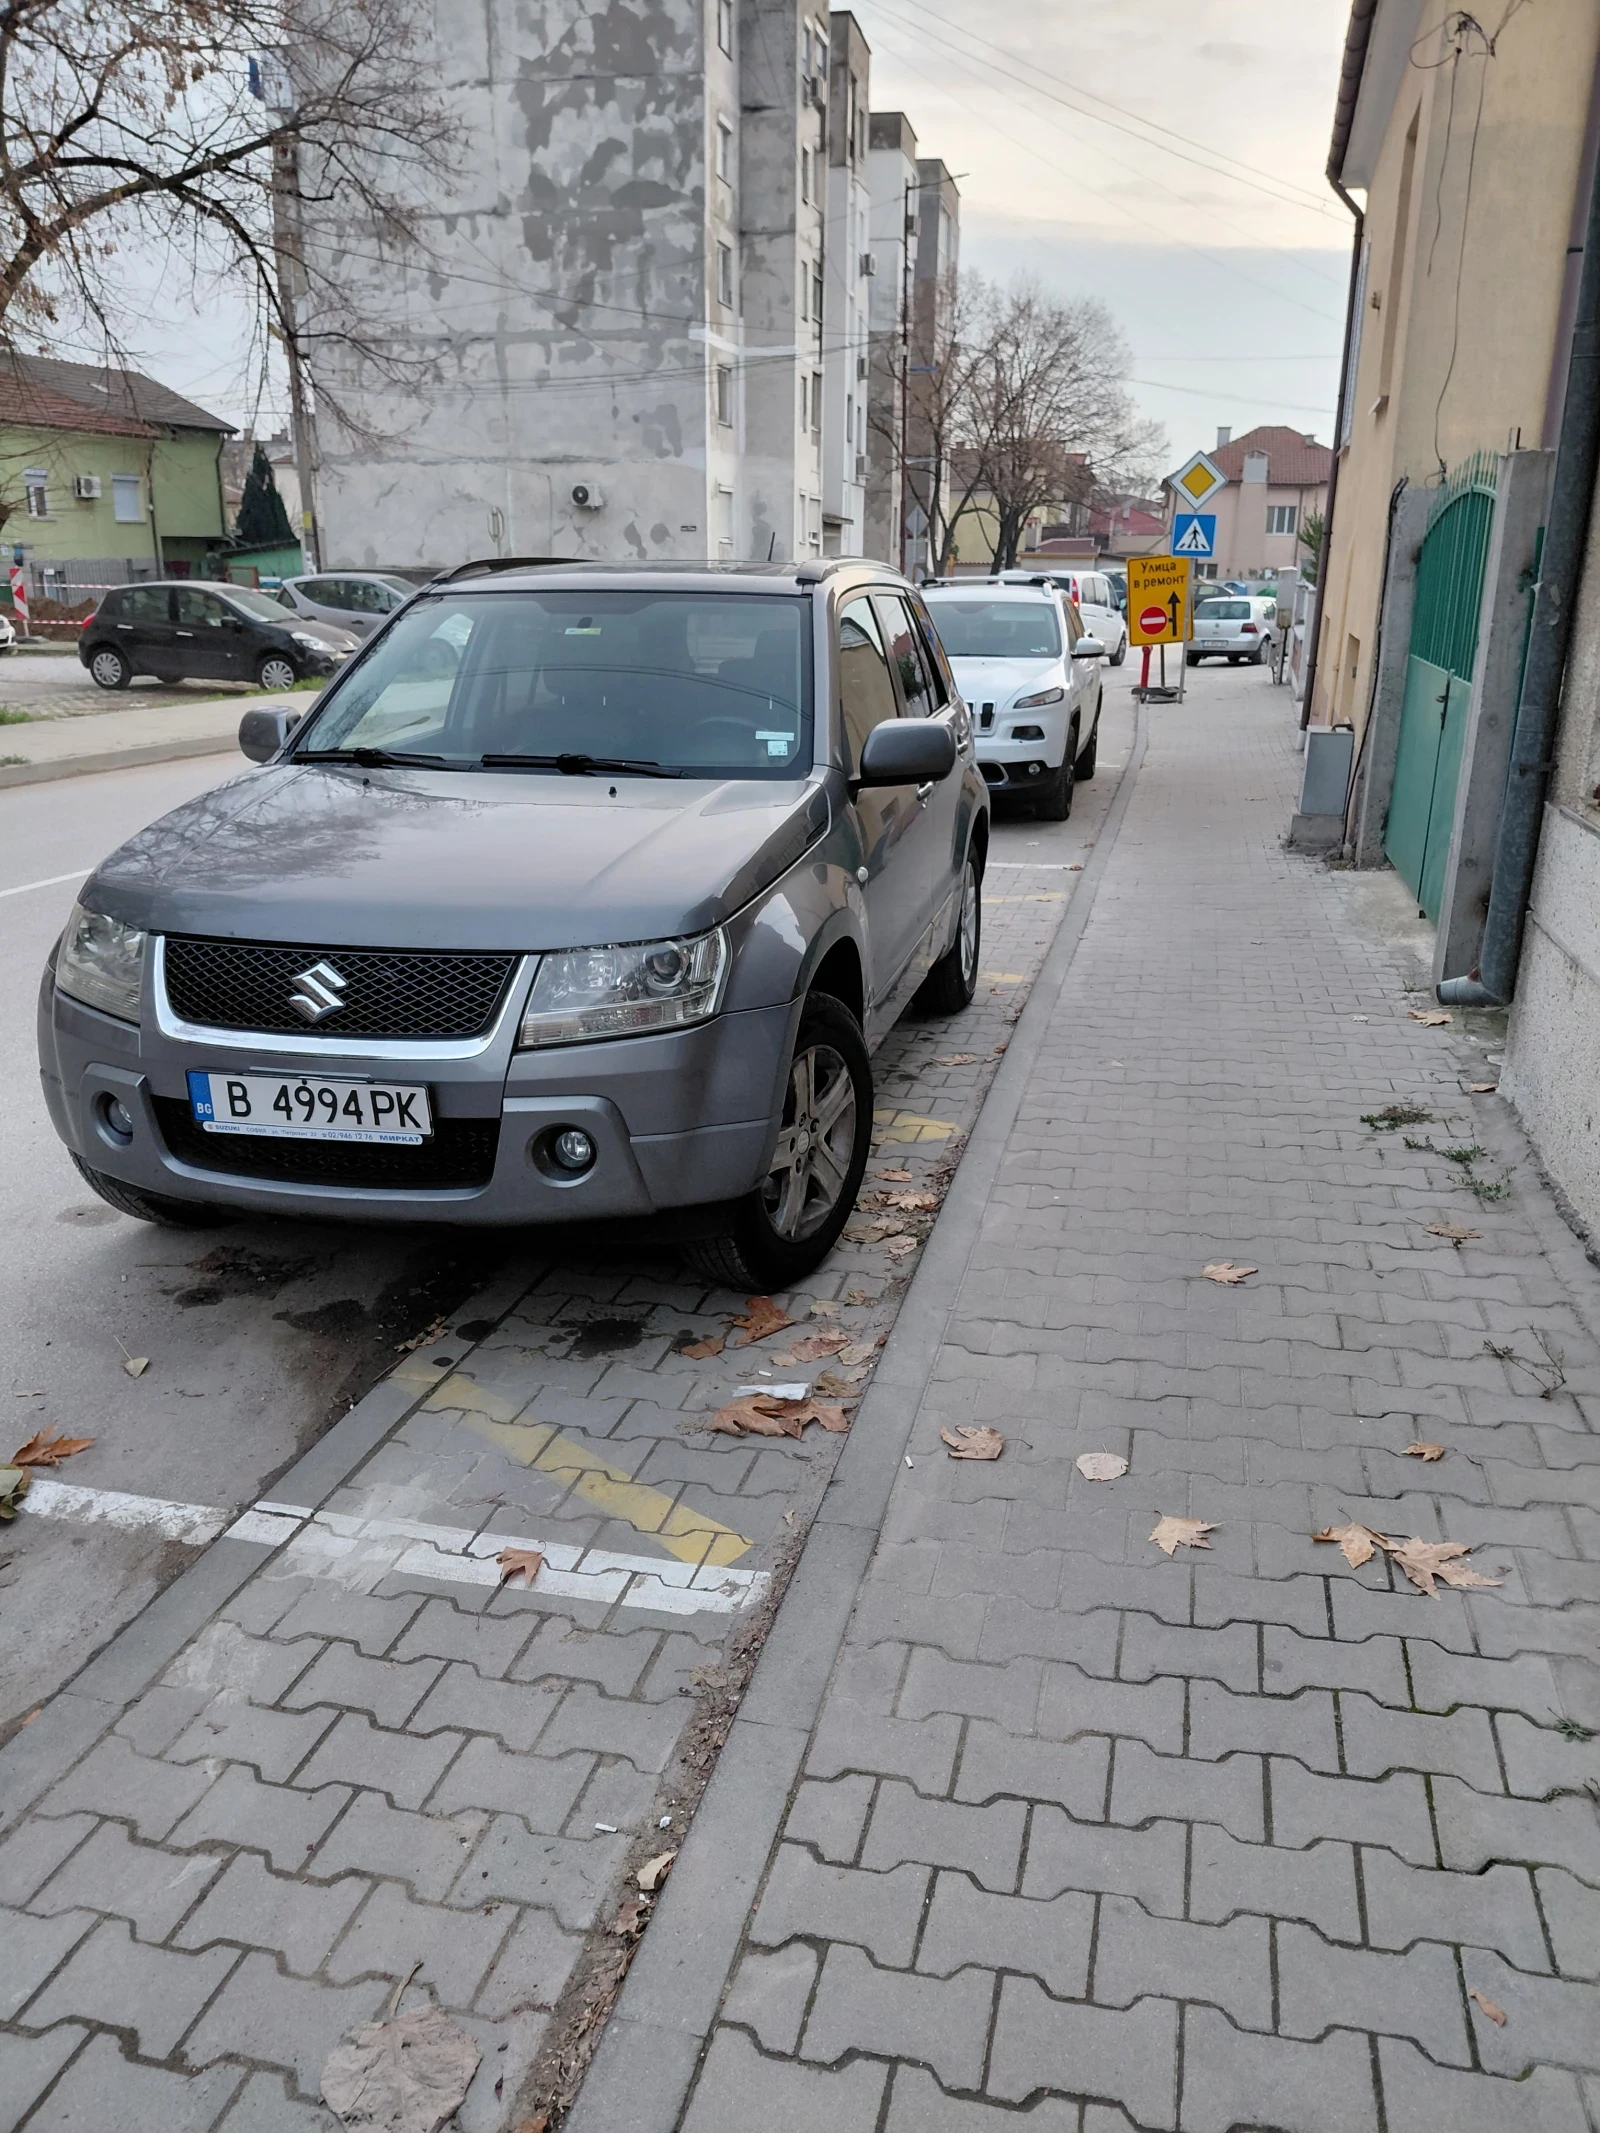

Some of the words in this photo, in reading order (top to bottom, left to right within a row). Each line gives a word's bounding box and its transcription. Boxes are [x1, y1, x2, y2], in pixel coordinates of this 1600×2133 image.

[1141, 562, 1176, 573] Улица
[1133, 580, 1140, 589] в
[1144, 575, 1184, 590] ремонт
[226, 1080, 251, 1117] B
[196, 1102, 213, 1115] BG
[215, 1124, 241, 1132] SUZUKI
[379, 1134, 420, 1143] МИРКАТ
